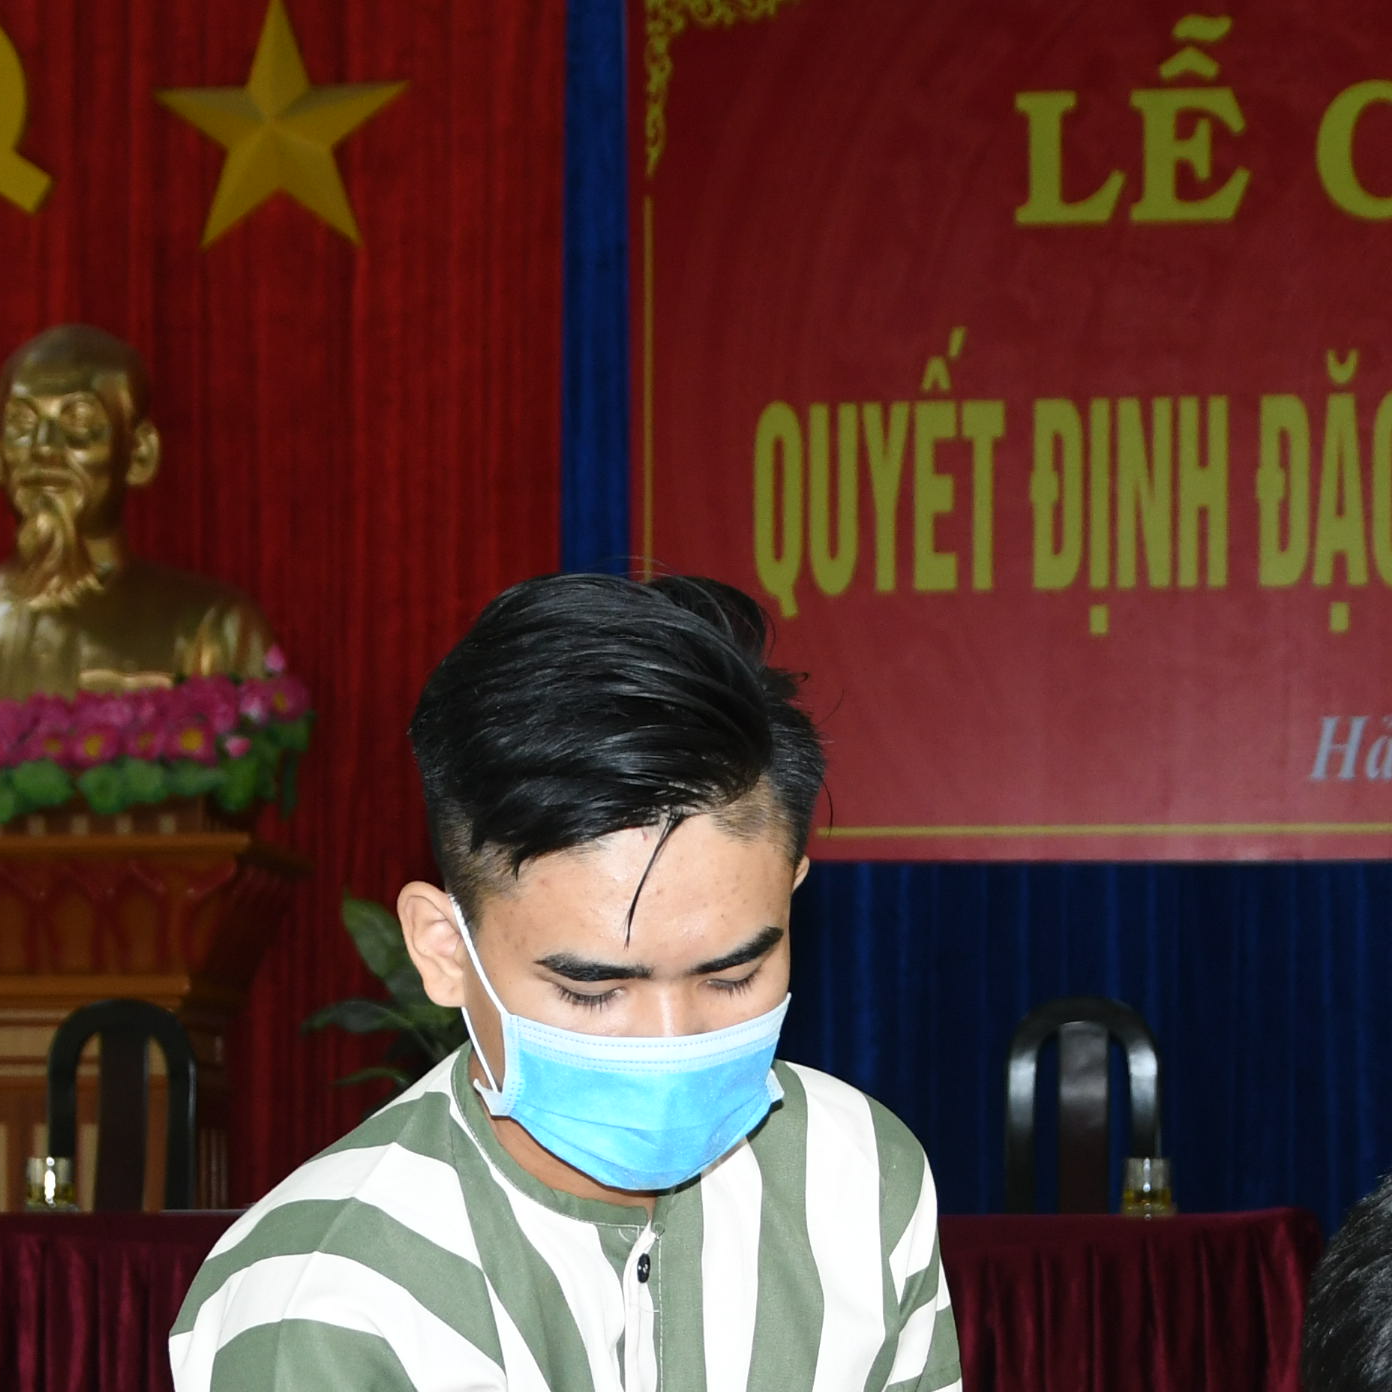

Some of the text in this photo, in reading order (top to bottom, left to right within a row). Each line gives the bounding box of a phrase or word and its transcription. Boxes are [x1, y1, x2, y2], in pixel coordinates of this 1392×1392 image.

[1015, 14, 1249, 225] LỄ
[753, 327, 1005, 617] QUYẾT
[1030, 395, 1228, 635] ĐỊNH
